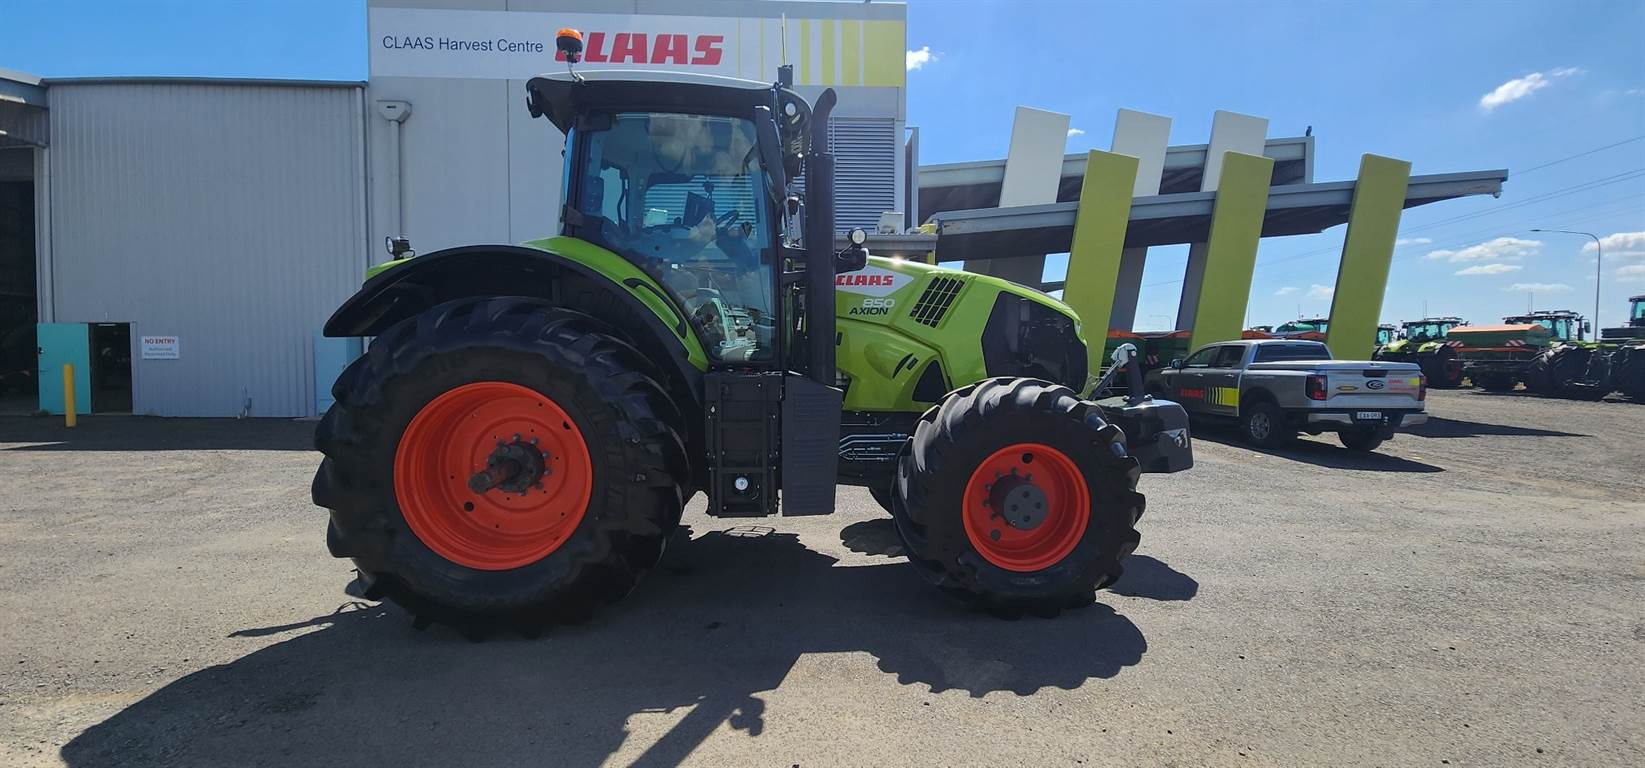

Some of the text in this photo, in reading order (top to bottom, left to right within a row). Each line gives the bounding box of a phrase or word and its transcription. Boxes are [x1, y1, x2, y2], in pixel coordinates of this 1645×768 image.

[383, 35, 544, 53] CLAAS Harvest Centre
[835, 275, 893, 286] CLAAS
[863, 298, 895, 308] 850
[849, 307, 889, 316] AXION
